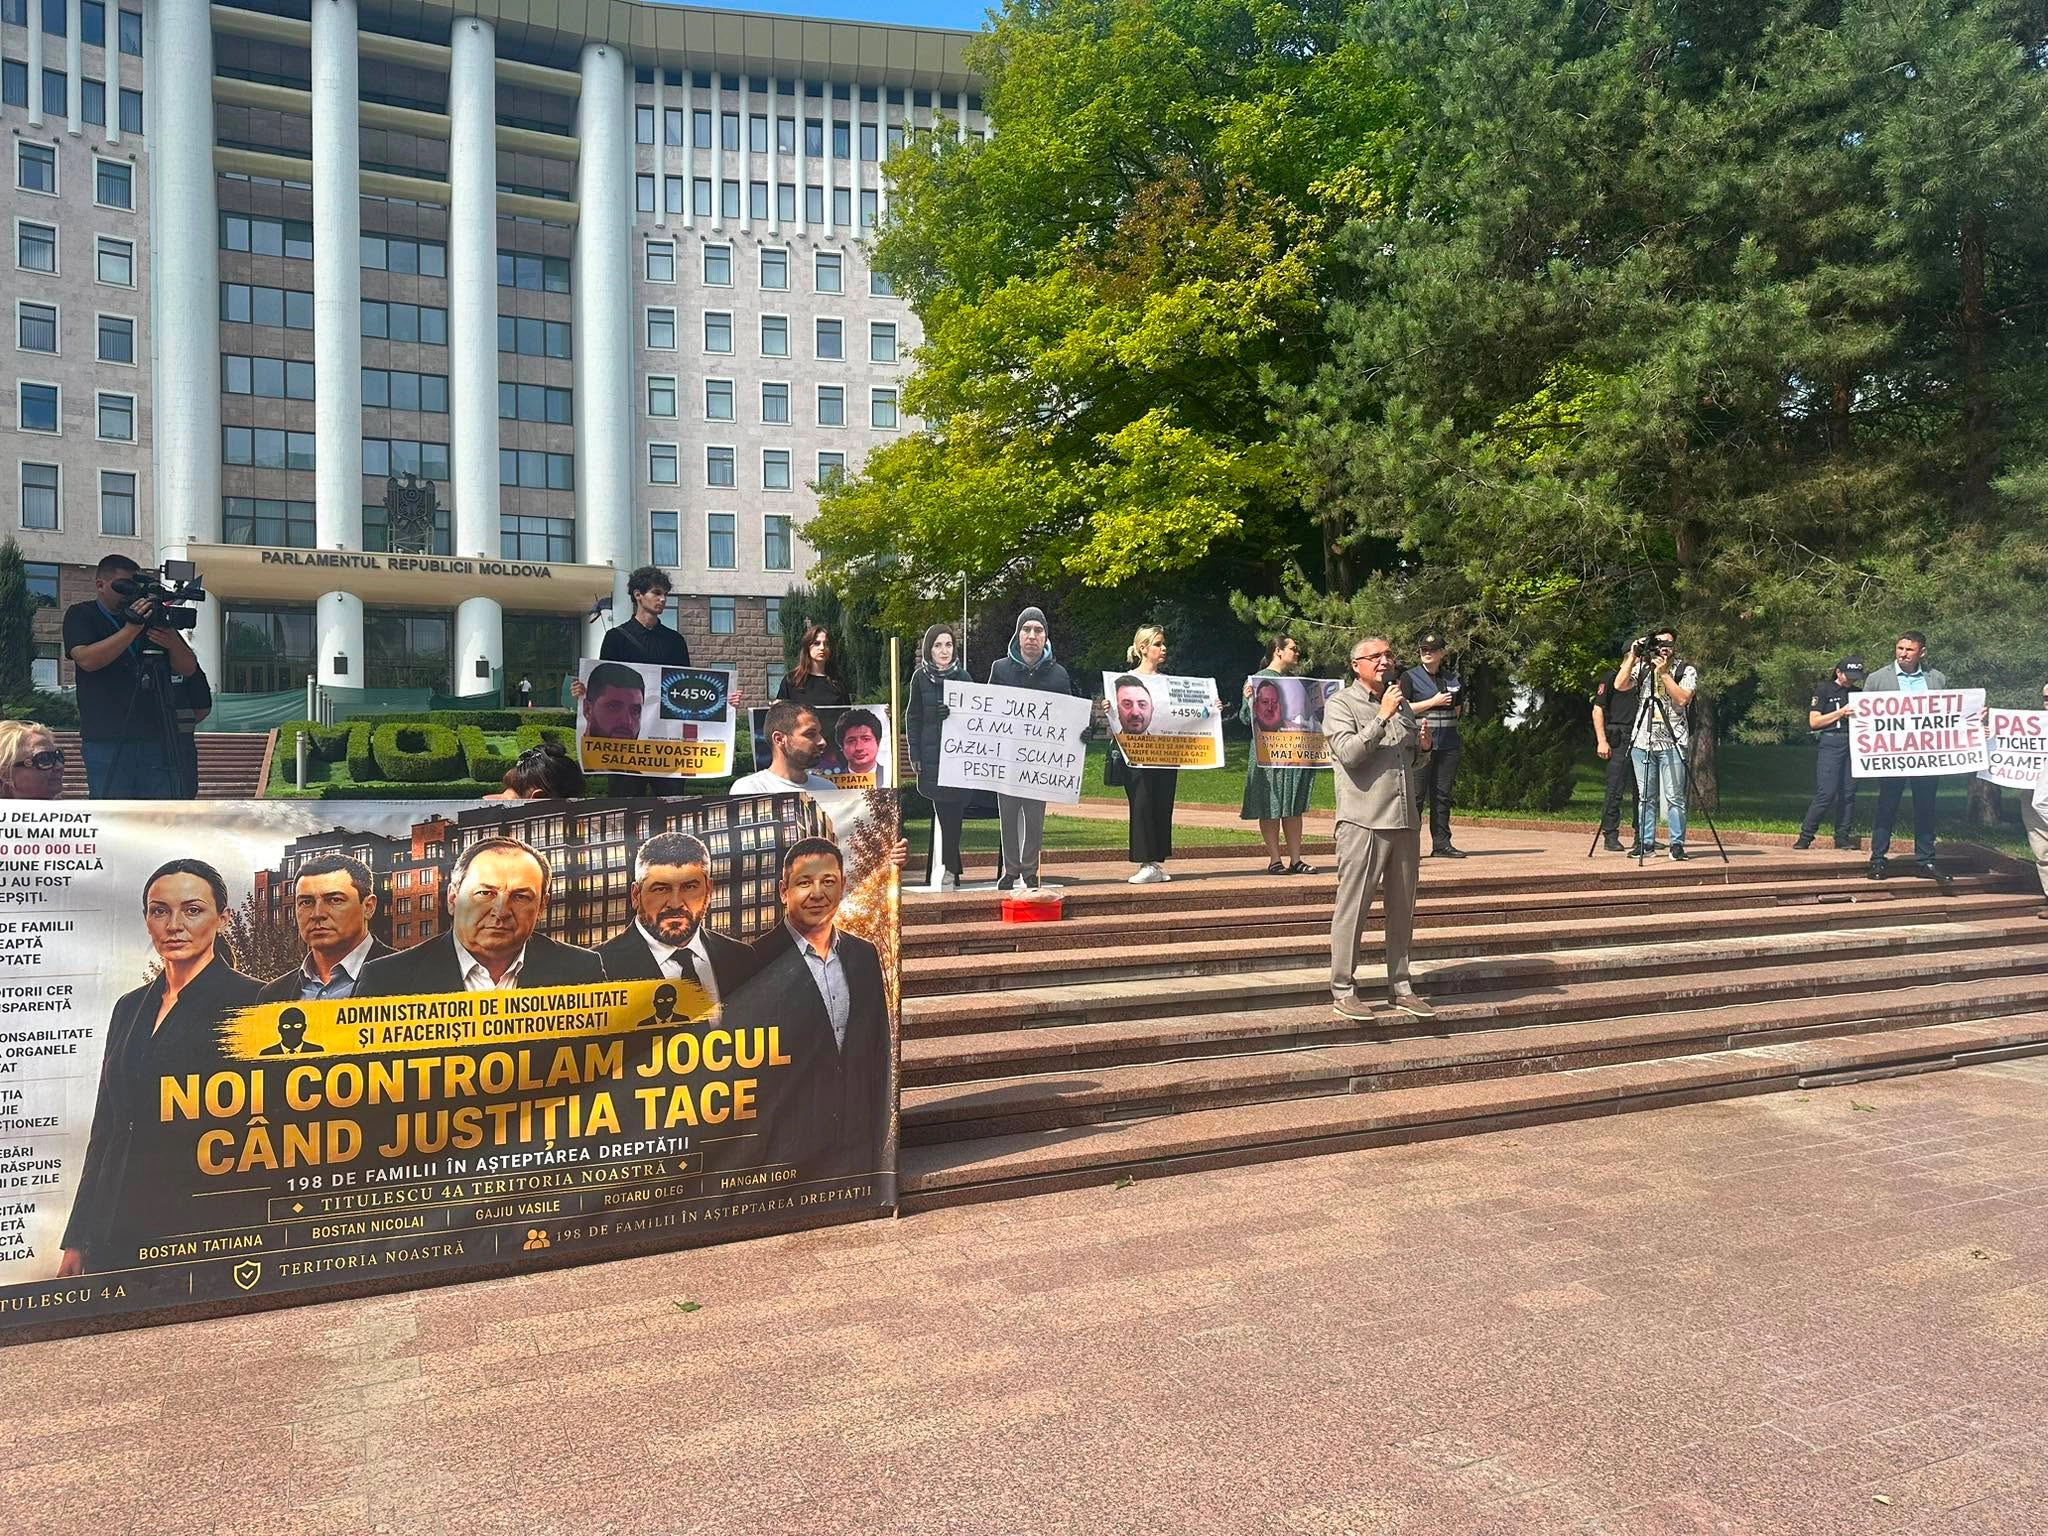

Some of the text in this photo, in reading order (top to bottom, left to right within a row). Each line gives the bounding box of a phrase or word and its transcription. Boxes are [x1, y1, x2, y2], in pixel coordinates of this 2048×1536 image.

[261, 551, 551, 578] PARLAMENTUL REPUBLICII MOLDOVA
[670, 688, 716, 701] +45%
[948, 692, 1052, 721] EI SE JURĂ
[1171, 708, 1201, 719] +45%
[967, 717, 1067, 742] CĂ NU FURĂ
[1874, 714, 1961, 732] DIN TARIF
[1995, 714, 2041, 736] PAS
[585, 740, 721, 758] TARIFELE VOASTRE,
[1857, 728, 1982, 754] SALARIILE
[601, 754, 703, 768] SALARIUL MEU
[1016, 747, 1076, 768] SCUMP
[1270, 750, 1292, 759] MAI
[1860, 752, 1983, 771] VERIȘOARELOR!
[1991, 753, 2047, 769] OAME
[964, 761, 1080, 794] PESTE MĂSURĂ!
[11, 812, 92, 823] DELAPIDAT
[27, 828, 54, 838] MAI
[60, 828, 99, 838] MULT
[14, 844, 40, 855] 000
[45, 844, 71, 855] 000
[75, 844, 96, 854] LEI
[44, 857, 103, 871] FISCALĂ
[11, 877, 31, 887] AU
[35, 876, 72, 887] FOST
[0, 921, 74, 933] DE FAMILII
[0, 985, 73, 998] ITORII CER
[0, 998, 72, 1013] SPARENȚĂ
[336, 990, 628, 1025] ADMINISTRATORI DE INSOLVABILITATE
[358, 1012, 609, 1046] ȘI AFACERIȘTI CONTROVERSAȚI
[6, 1044, 77, 1058] ORGANELE
[160, 1026, 792, 1122] NOI CONTROLAM JOCUL
[197, 1078, 757, 1176] CÂND JUSTIȚIA TACE
[1, 1159, 62, 1174] RĂSPUNS
[287, 1136, 689, 1192] 198 DE FAMILII ÎN AȘTEPTAREA DREPTĂȚII
[11, 1176, 28, 1187] DE
[31, 1174, 60, 1185] ZILE
[321, 1161, 667, 1211] TITULESCU 4A TERITORIA NOASTRĂ
[721, 1169, 797, 1189] HANGAN IGOR
[604, 1184, 684, 1206] ROTARU OLEG
[475, 1200, 560, 1221] GAJIU VASILE
[556, 1229, 581, 1242] 198
[589, 1225, 609, 1237] DE
[615, 1215, 676, 1234] FAMILII
[682, 1210, 698, 1224] ÎN
[704, 1197, 794, 1222] AȘTEPTAREA
[312, 1215, 424, 1239] BOSTAN NICOLAI
[139, 1234, 263, 1260] BOSTAN TATIANA
[279, 1240, 465, 1277] TERITORIA NOASTRĂ
